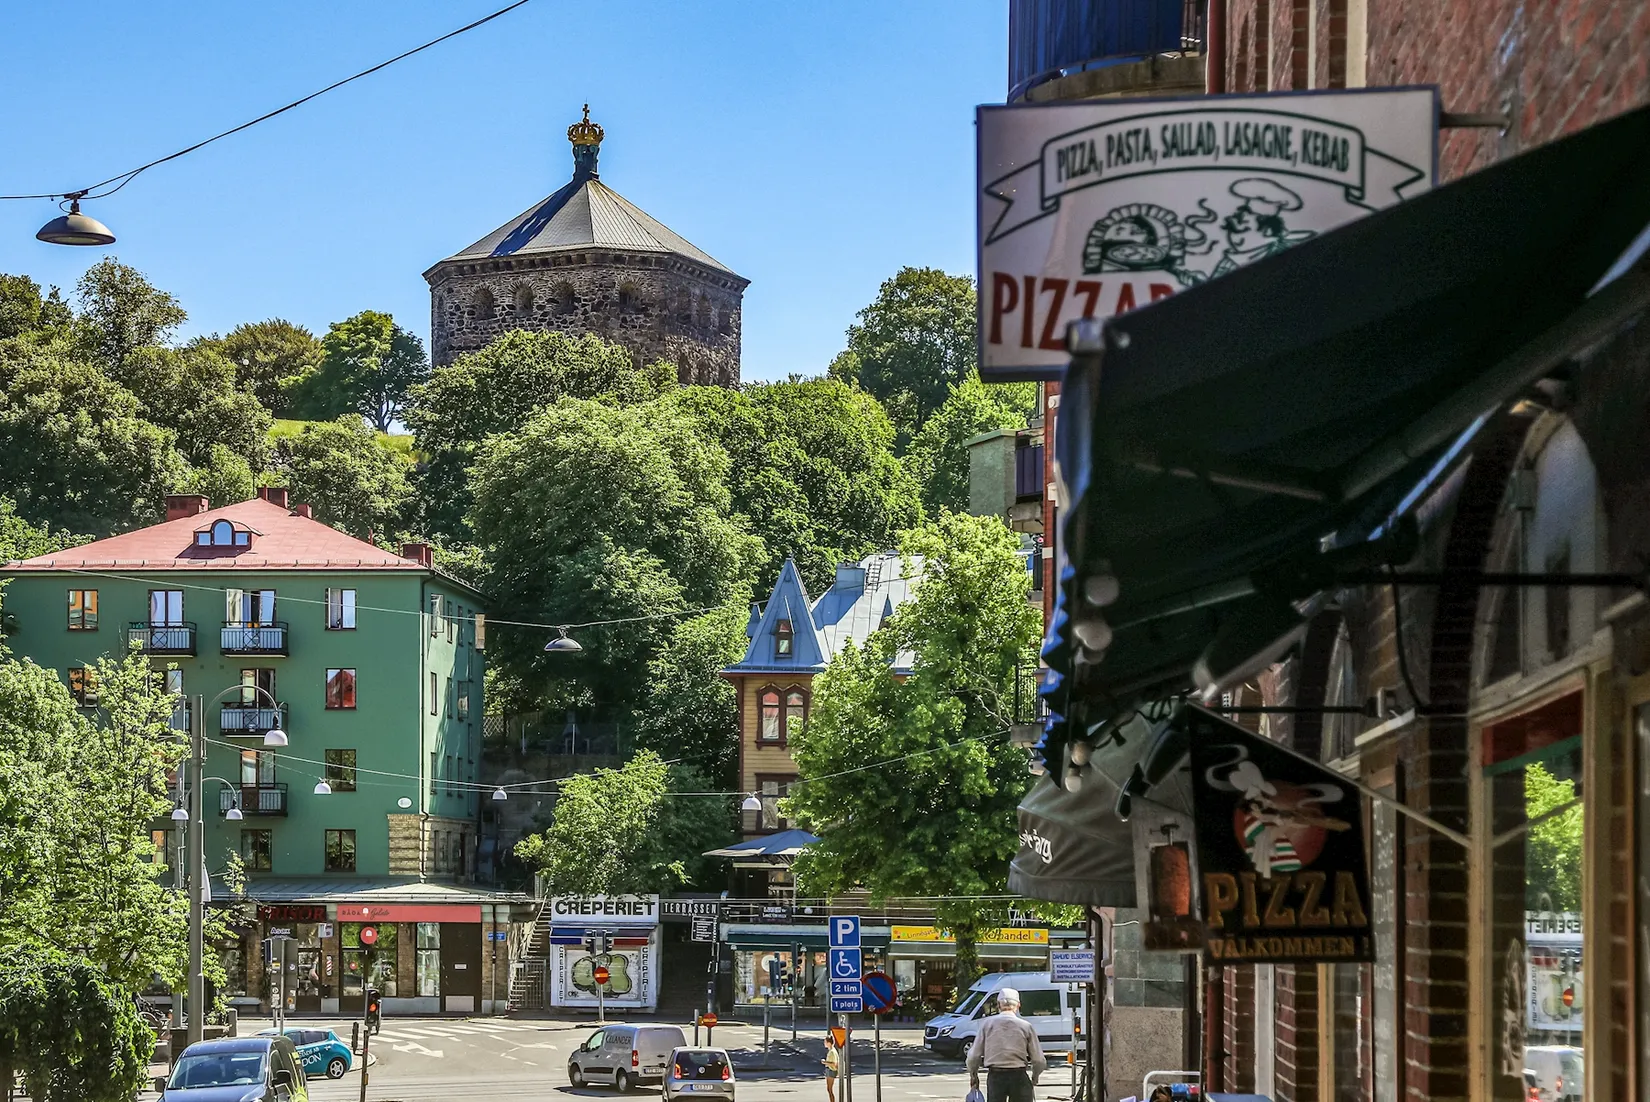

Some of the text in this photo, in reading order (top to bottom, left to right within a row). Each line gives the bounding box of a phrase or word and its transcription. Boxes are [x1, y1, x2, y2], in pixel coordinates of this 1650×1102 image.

[1057, 121, 1349, 183] PIZZA, PASTA, SALLAD, LASAGNE, KEBAB
[555, 900, 656, 916] CREPERIET
[664, 903, 717, 914] TERRASSEN
[1203, 871, 1367, 929] PIZZA
[837, 919, 855, 944] P
[1207, 933, 1355, 959] VÄLKOMMEN
[835, 984, 857, 992] 2 tim
